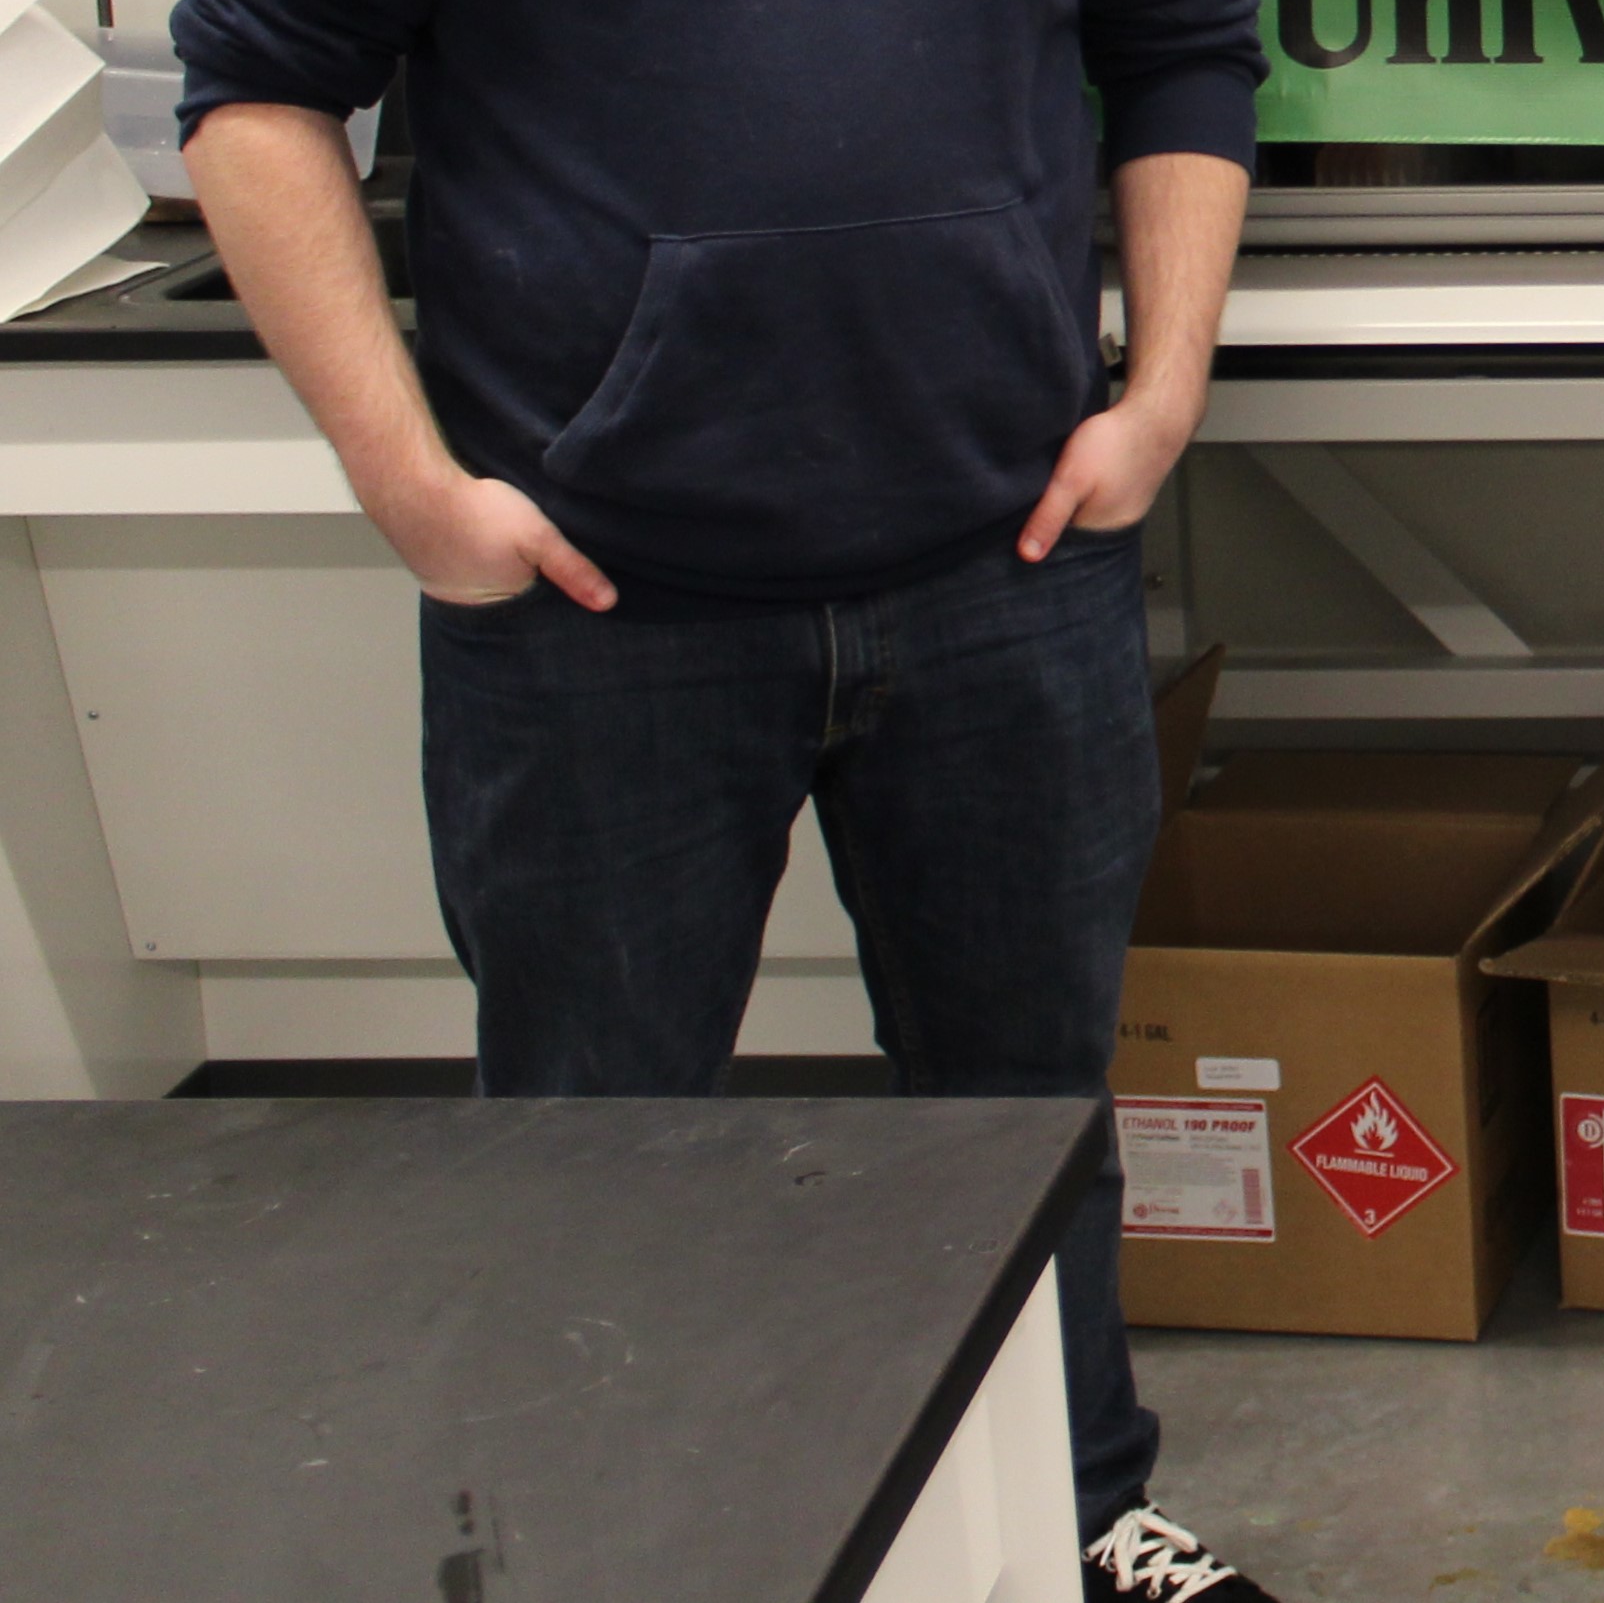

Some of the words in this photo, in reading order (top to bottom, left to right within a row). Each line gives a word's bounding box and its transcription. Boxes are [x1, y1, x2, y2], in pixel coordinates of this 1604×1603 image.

[1122, 1117, 1178, 1131] ETHANOL
[1211, 1120, 1257, 1134] PROOF
[1315, 1154, 1388, 1178] FLAMMABLE
[1389, 1164, 1429, 1183] LIQUID
[1364, 1208, 1376, 1226] 3
